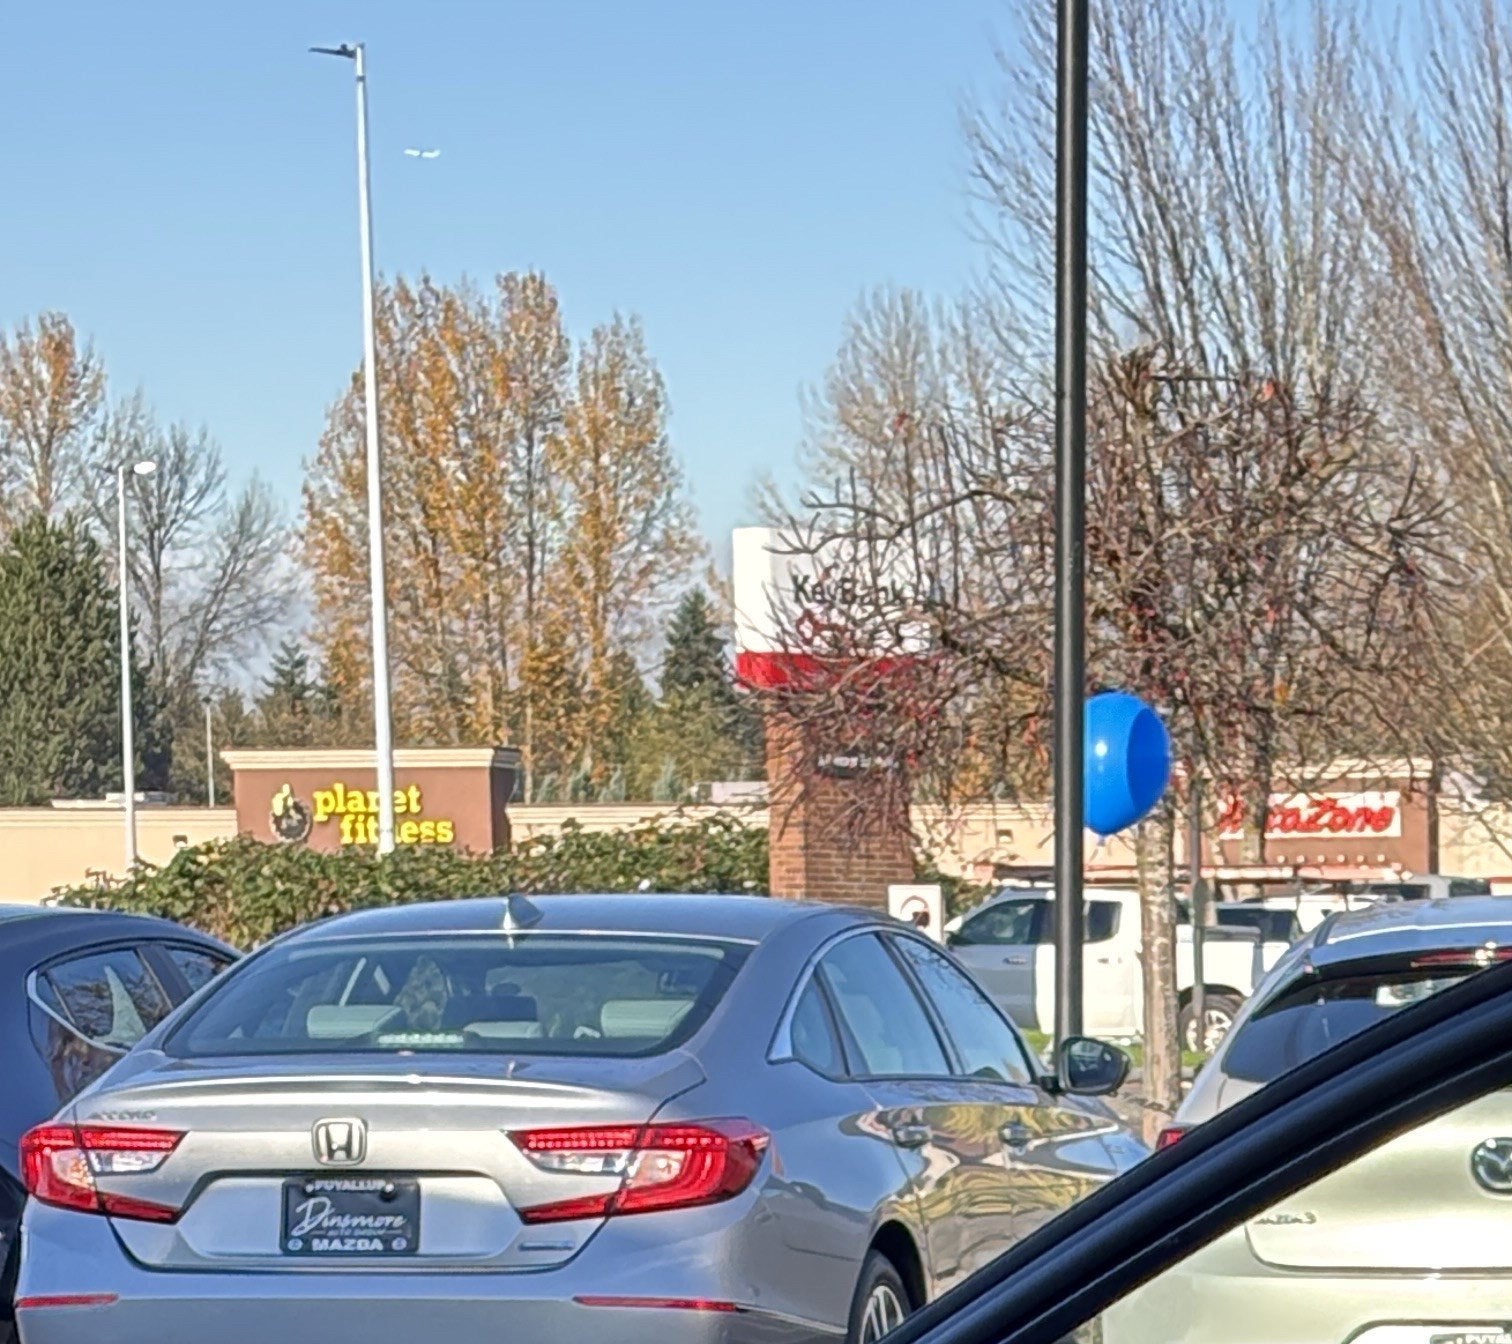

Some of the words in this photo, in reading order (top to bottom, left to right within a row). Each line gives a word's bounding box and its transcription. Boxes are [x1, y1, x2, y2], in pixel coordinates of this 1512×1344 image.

[340, 814, 454, 843] fitess
[291, 1196, 407, 1236] Dinsmore
[311, 1238, 384, 1251] MAZDA
